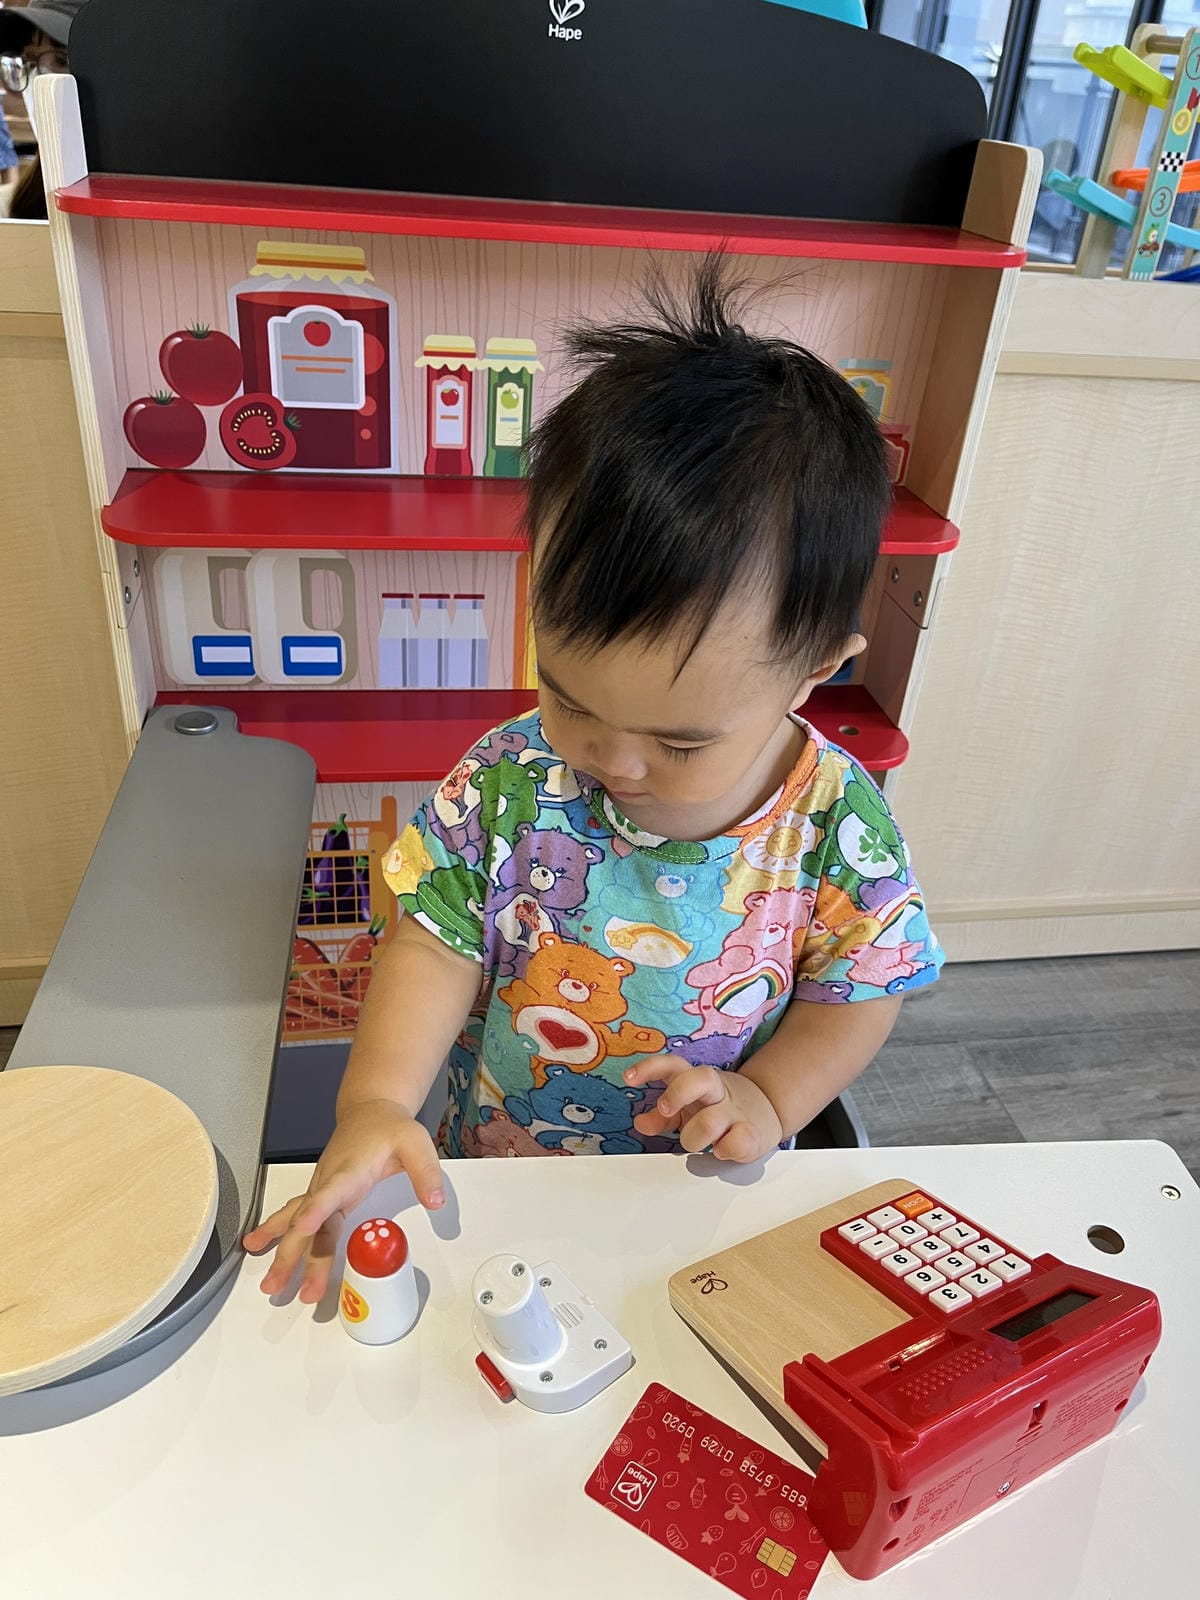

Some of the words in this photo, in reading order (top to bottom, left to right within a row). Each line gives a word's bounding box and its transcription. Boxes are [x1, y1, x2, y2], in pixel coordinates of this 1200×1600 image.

[549, 23, 583, 41] Hape
[1156, 192, 1166, 211] 3
[900, 1225, 916, 1235] 0
[955, 1227, 969, 1238] 7
[923, 1240, 939, 1251] 8
[976, 1244, 991, 1254] 4
[893, 1254, 908, 1264] 9
[947, 1257, 963, 1267] 5
[1003, 1260, 1017, 1270] 1
[690, 1270, 717, 1284] Hape
[916, 1271, 932, 1282] 6
[971, 1273, 989, 1285] 2
[941, 1288, 958, 1300] 3
[343, 1288, 361, 1318] S
[661, 1411, 695, 1438] 0920
[700, 1435, 734, 1463] 0129
[627, 1467, 652, 1488] Hape
[739, 1459, 774, 1488] 5758
[780, 1484, 808, 1511] 685
